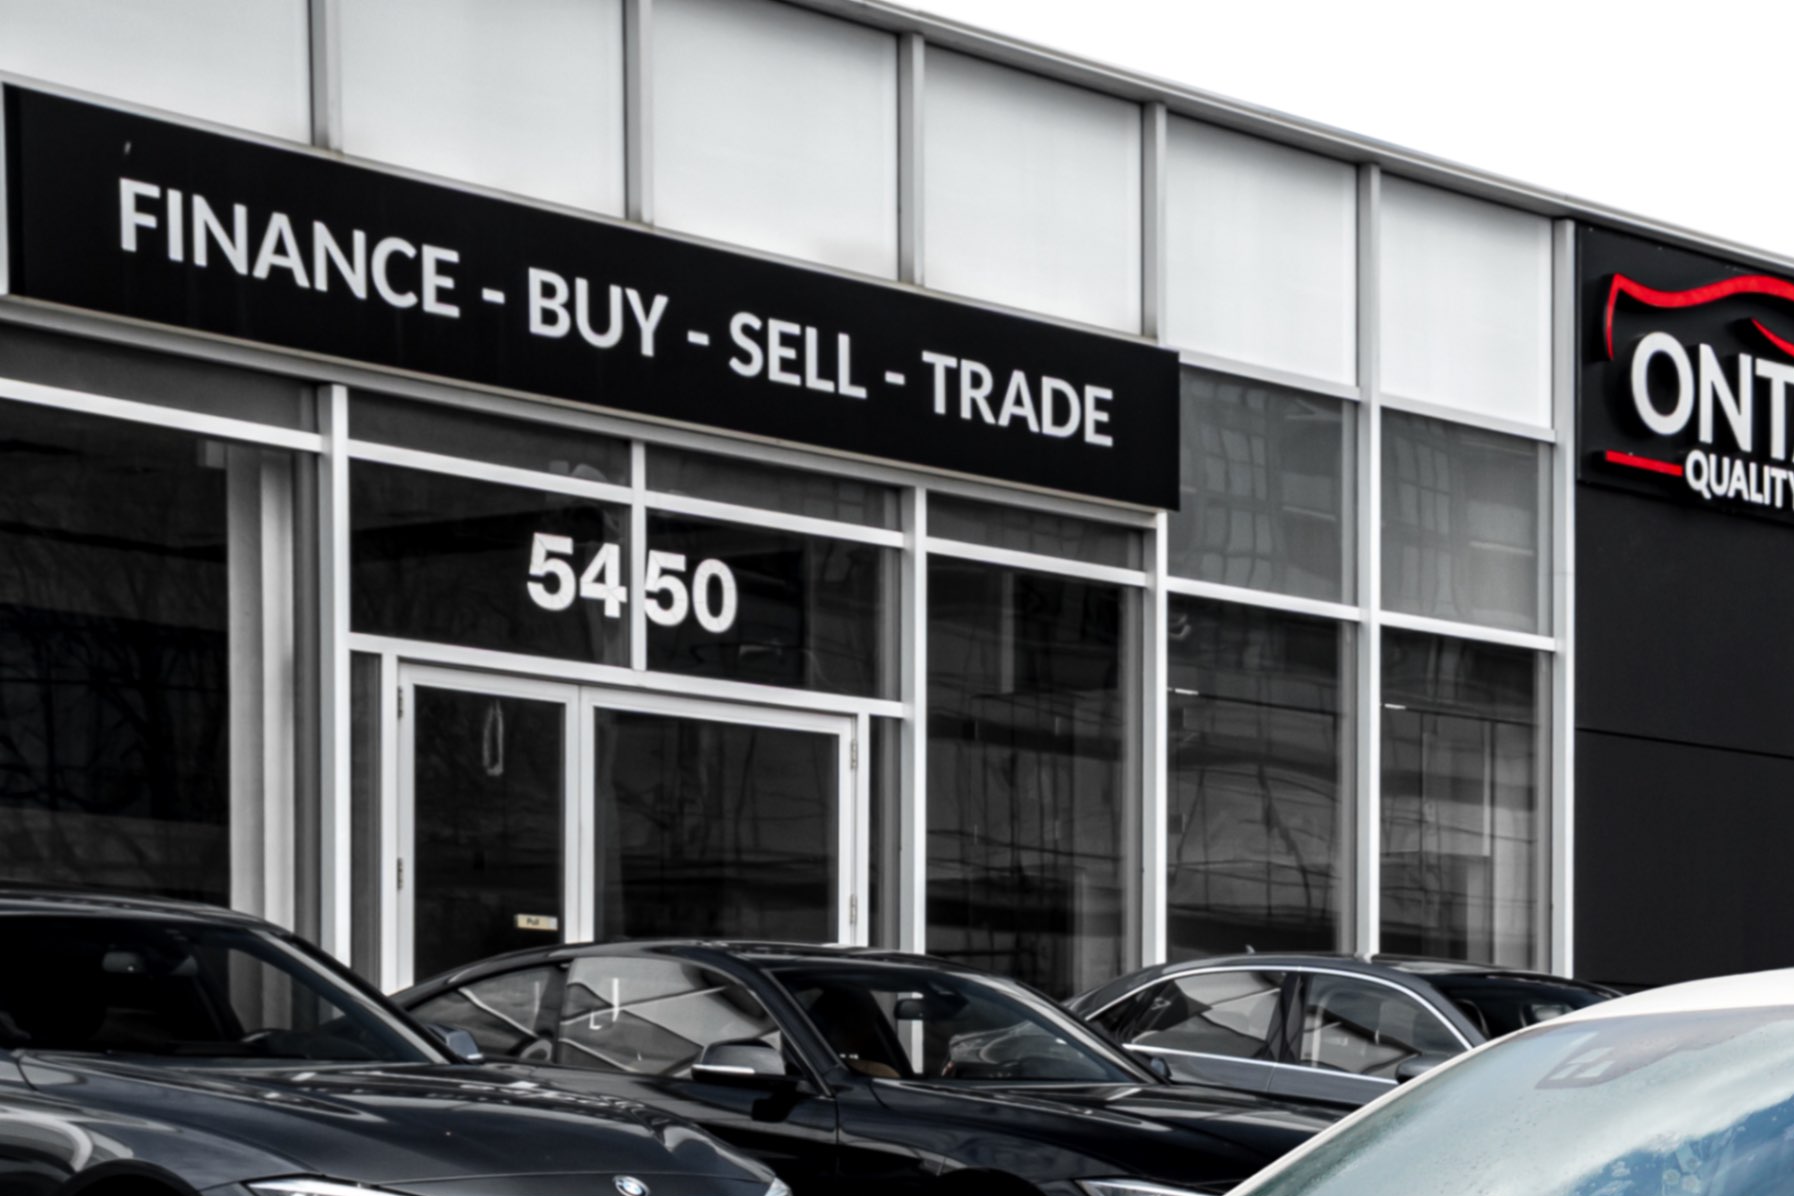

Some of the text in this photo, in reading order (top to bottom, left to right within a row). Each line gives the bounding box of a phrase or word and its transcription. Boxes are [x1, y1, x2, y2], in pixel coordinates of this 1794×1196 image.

[119, 177, 461, 318] FINANCE
[528, 266, 669, 357] BUY
[728, 311, 868, 399] SELL
[921, 350, 1114, 447] TRADE
[526, 531, 738, 634] 5450
